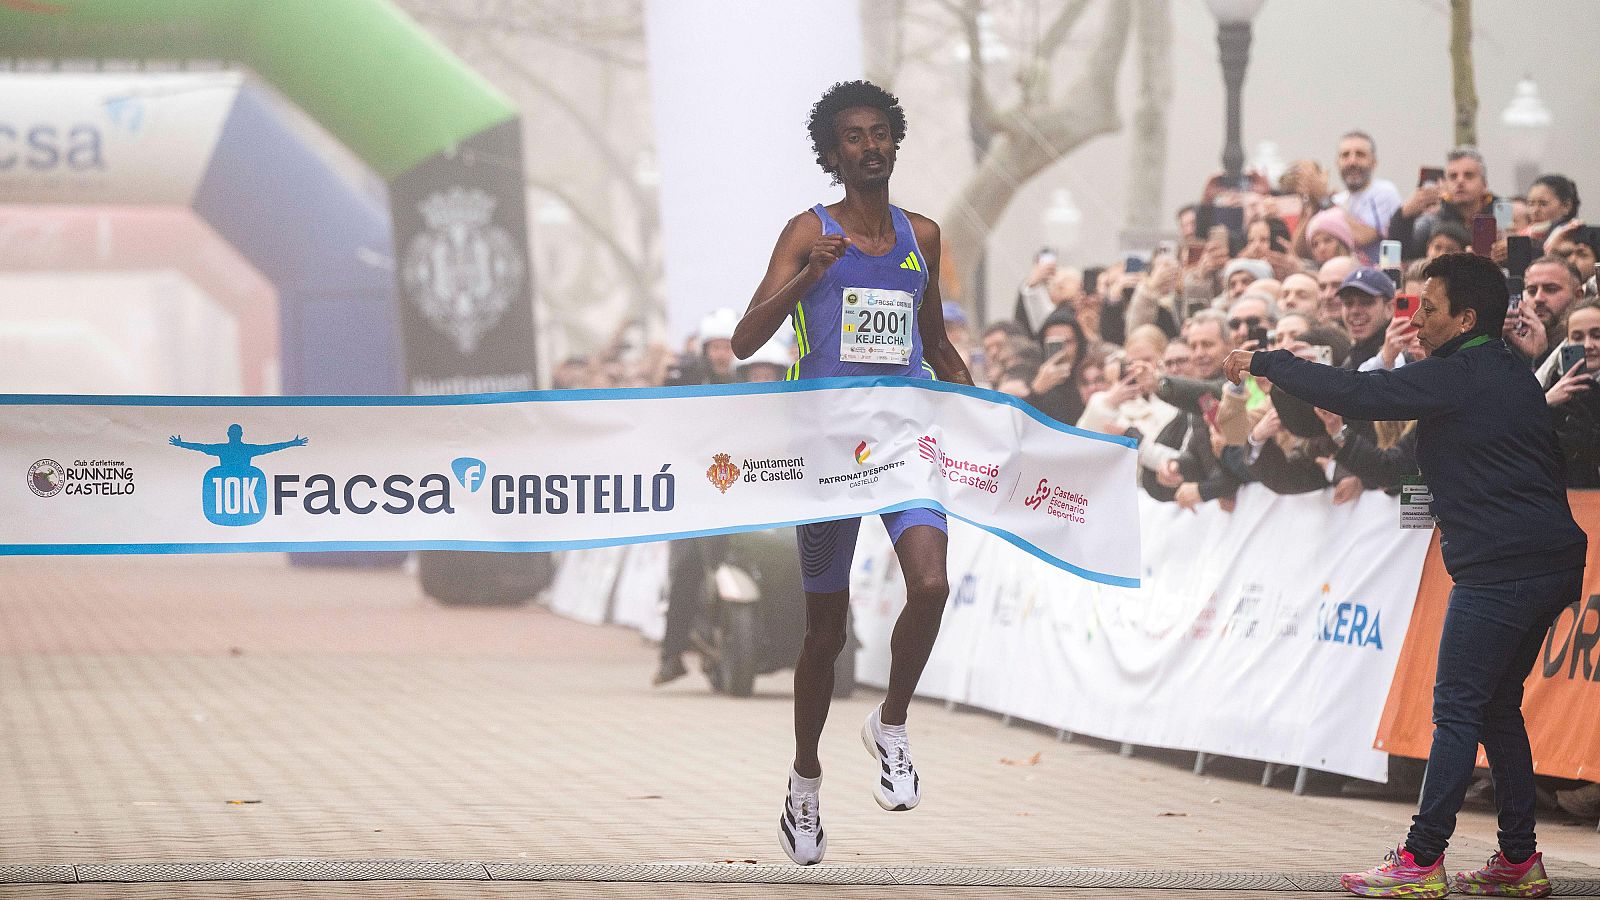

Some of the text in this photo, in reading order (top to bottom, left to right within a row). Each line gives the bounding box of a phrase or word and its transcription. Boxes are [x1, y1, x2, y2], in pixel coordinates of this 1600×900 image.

[858, 310, 906, 335] 2001
[855, 334, 905, 346] KEJELCHA
[90, 459, 125, 467] d'atletisme
[742, 456, 805, 470] Ajuntament
[66, 467, 134, 480] RUNNING
[743, 468, 804, 483] de Castelló
[818, 460, 905, 485] PATRONAT D'ESPORTS
[65, 478, 135, 495] CASTELLÓ
[212, 477, 260, 515] 10K
[491, 463, 675, 514] CASTELLÓ
[849, 476, 879, 488] CASTELLÓ
[948, 470, 999, 494] Castelló
[1050, 496, 1085, 515] Escenario
[1054, 486, 1088, 507] Castellón
[1047, 505, 1086, 524] Deportivo
